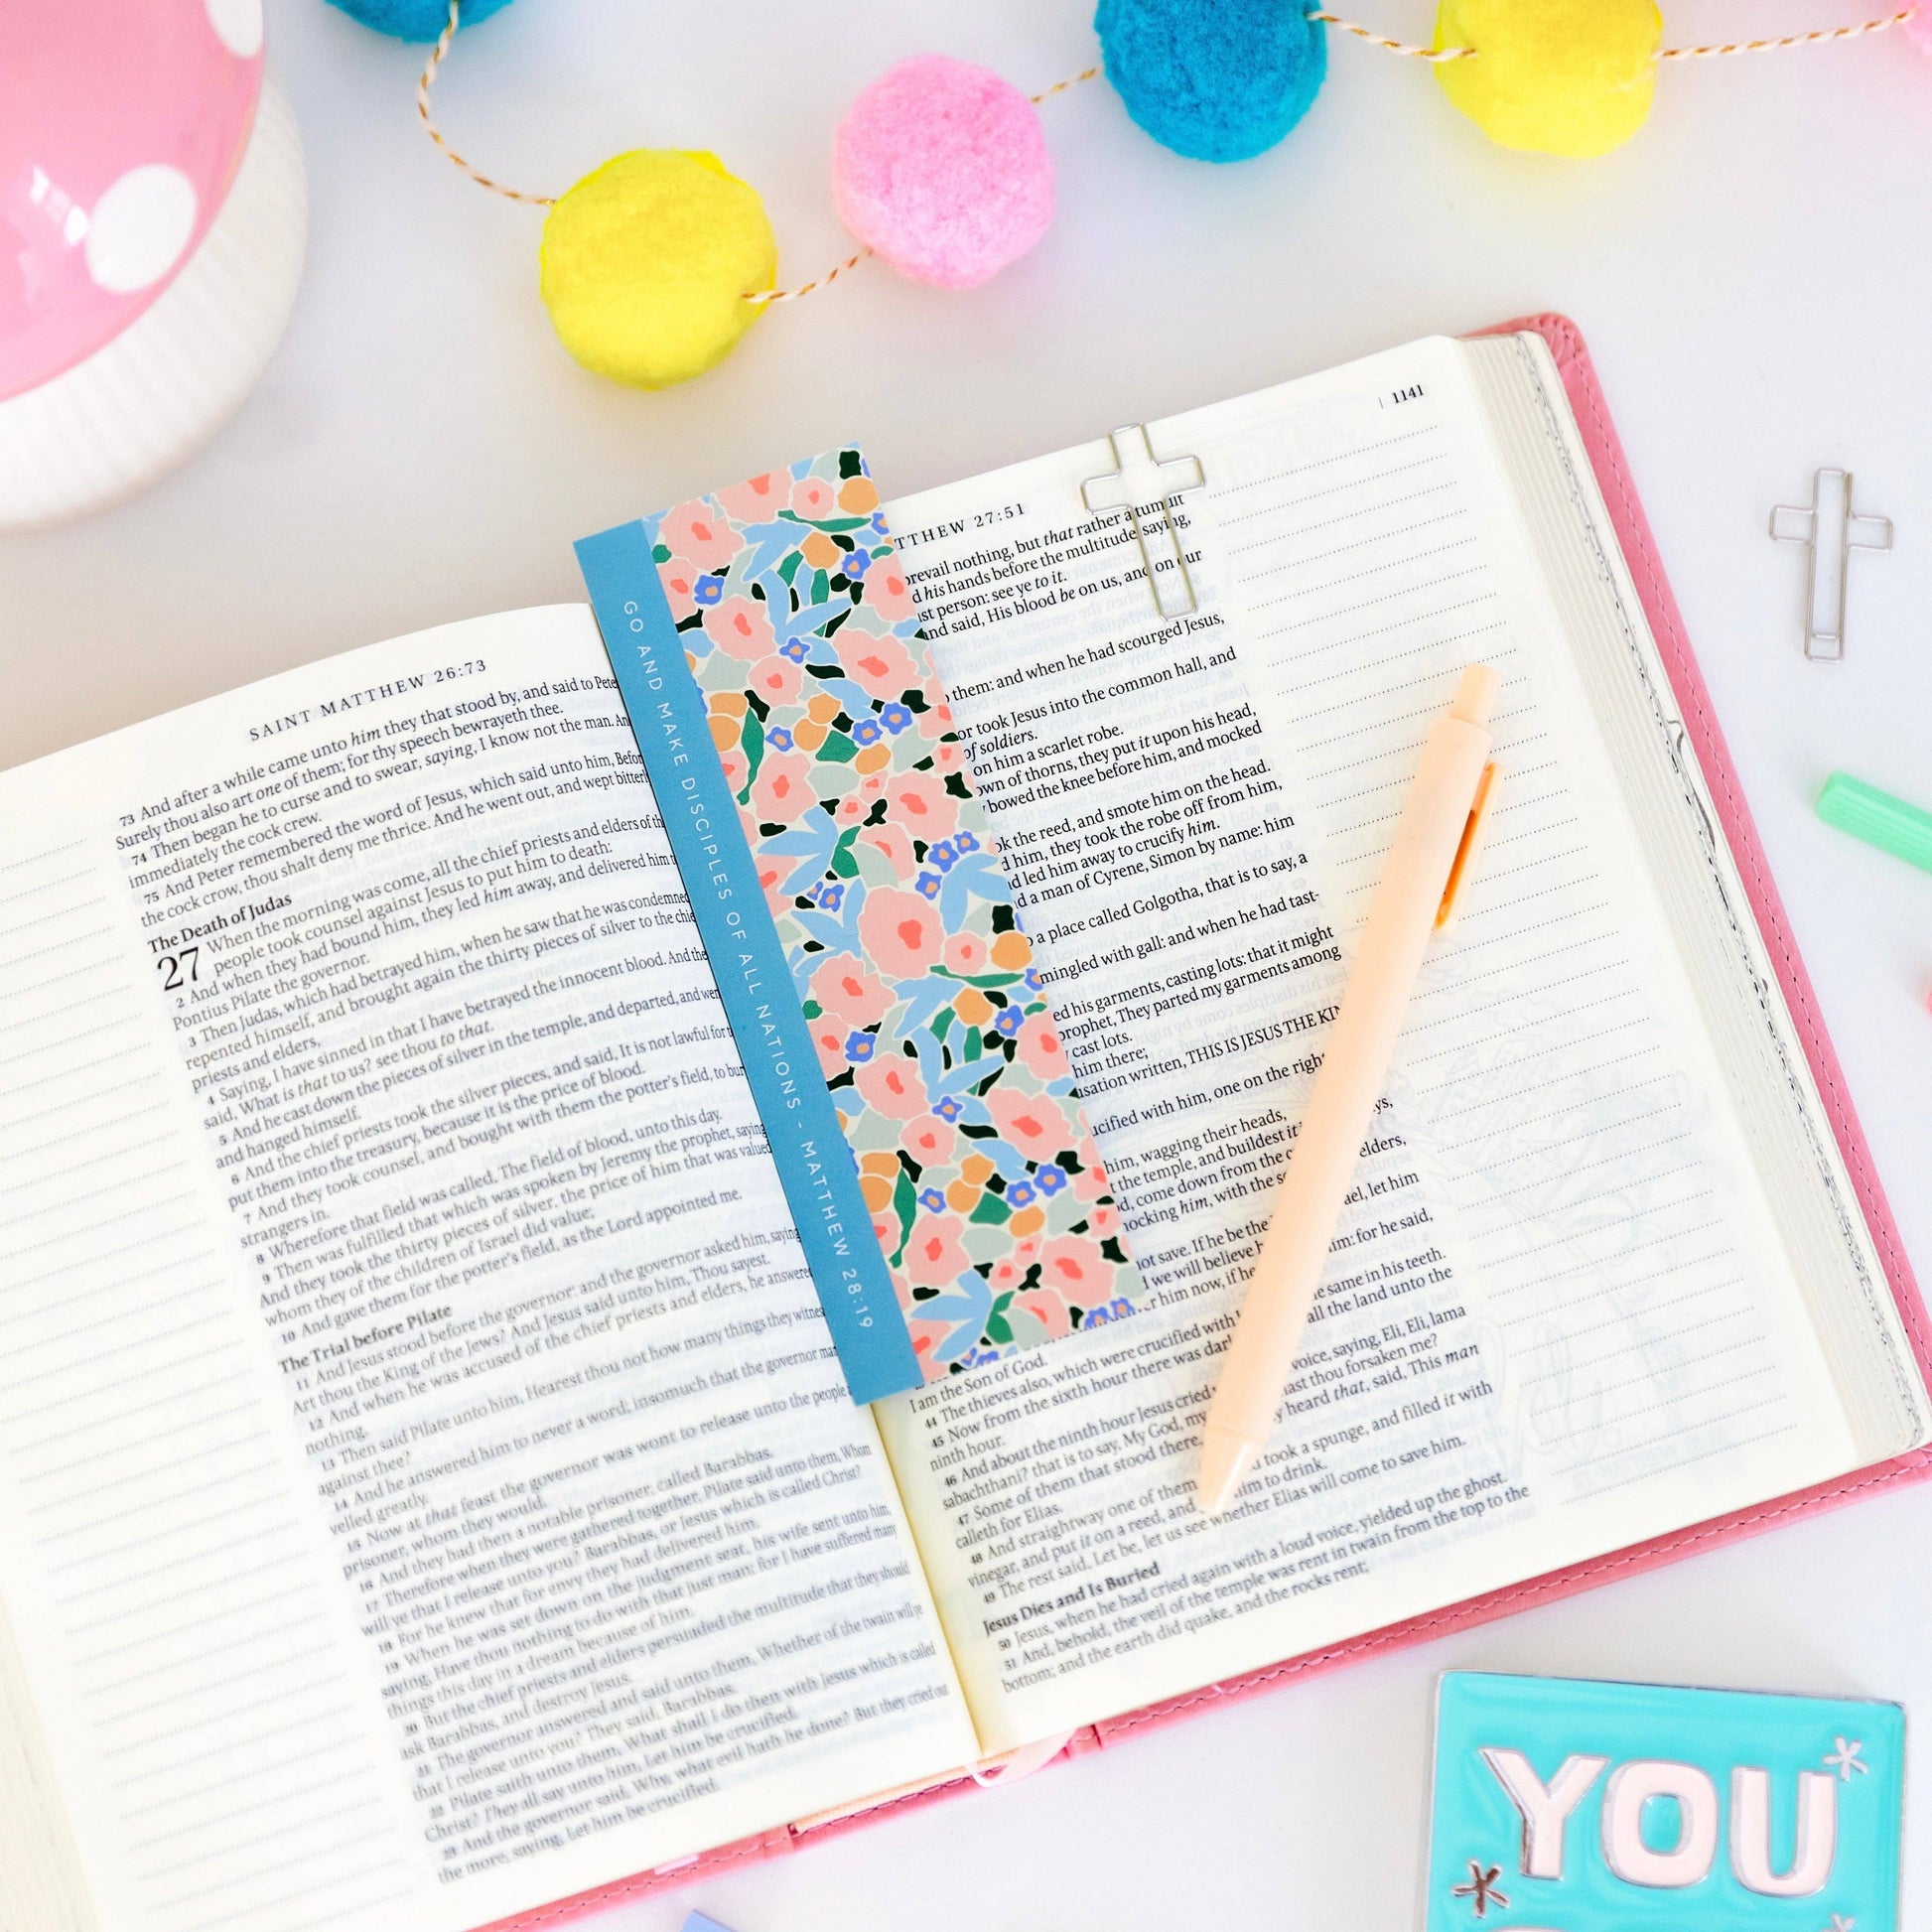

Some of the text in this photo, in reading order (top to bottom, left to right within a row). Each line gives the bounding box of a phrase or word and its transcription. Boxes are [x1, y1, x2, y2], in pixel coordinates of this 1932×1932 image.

[1392, 384, 1424, 404] 1141
[894, 502, 1025, 550] TTHEW 27:51
[952, 513, 1121, 572] nothing, but that rather
[951, 614, 1224, 701] them: and when he had scourged Jesus,
[249, 659, 485, 742] SAINT MATTHEW 26:73
[115, 703, 564, 850] Surely thou also art one of them; for thy speech bewrayeth thee.
[118, 677, 594, 827] 73 And after a while came unto him they that stood by, and said to
[973, 725, 1124, 776] on him a scarlet robe.
[206, 813, 652, 953] When the morning was come, all the chief priests and elders of
[1035, 853, 1309, 944] a place called Golgotha, that is to say, a
[147, 895, 292, 953] The Death of Judas
[1038, 890, 1319, 989] mingled with gall: and when he had tast-
[157, 946, 199, 992] 27
[172, 953, 370, 1032] Pontius Pilate the governor.
[623, 601, 643, 632] GO
[636, 645, 663, 690] AND
[656, 702, 689, 766] MAKE
[680, 776, 733, 899] DISCIPLES
[726, 911, 747, 939] OF
[738, 953, 761, 995] ALL
[756, 1004, 801, 1109] NATIONS
[800, 1140, 850, 1256] MATTHEW
[841, 1268, 874, 1327] 28:19
[191, 1036, 321, 1094] priests and elders,
[1071, 1047, 1149, 1079] him there;
[1128, 1013, 1317, 1082] written, THIS IS JESUS THE
[215, 1105, 361, 1170] and hanged himself.
[239, 1209, 331, 1249] strangers in.
[279, 1306, 452, 1373] The Trial before Pilate
[1291, 1306, 1466, 1371] voice, saying, Eli, Eli, lama
[908, 1398, 917, 1414] I
[917, 1394, 939, 1411] am
[939, 1385, 963, 1402] the
[963, 1374, 993, 1393] Son
[994, 1363, 1010, 1382] of
[1012, 1352, 1048, 1375] God.
[929, 1436, 1006, 1471] ninth hour.
[342, 1493, 548, 1581] prisoner, whom they would.
[955, 1503, 1063, 1550] calleth for Elias.
[982, 1561, 1161, 1637] Jesus Dies and Is Buried
[437, 1866, 463, 1883] the
[565, 1822, 591, 1841] Let
[590, 1812, 623, 1831] him
[624, 1804, 646, 1820] be
[1479, 1747, 1838, 1898] YOU
